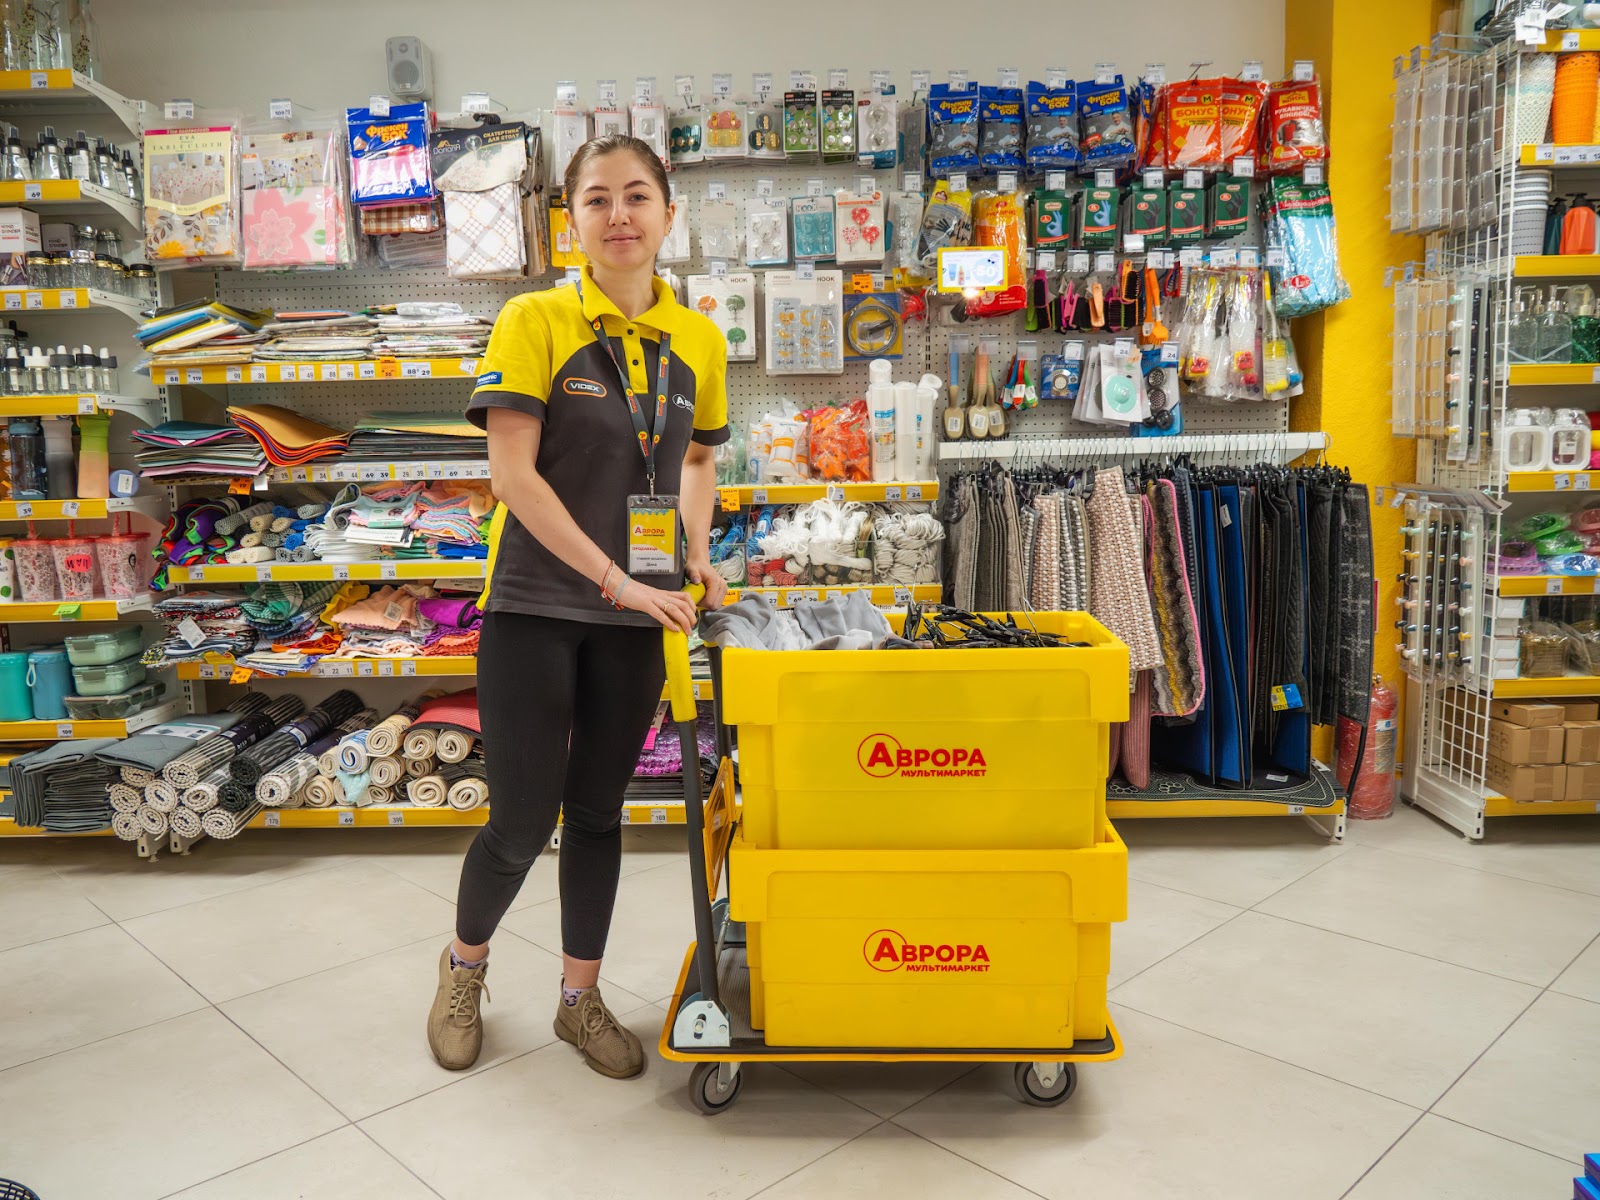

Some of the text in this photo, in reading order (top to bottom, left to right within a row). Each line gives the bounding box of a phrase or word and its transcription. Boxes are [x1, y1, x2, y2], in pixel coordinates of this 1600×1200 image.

[1100, 97, 1120, 106] БОК
[951, 106, 972, 114] БОК
[1176, 108, 1214, 117] БОНУС
[570, 382, 600, 392] VIDEX
[867, 742, 987, 767] АВРОРА
[872, 937, 990, 962] АВРОРА
